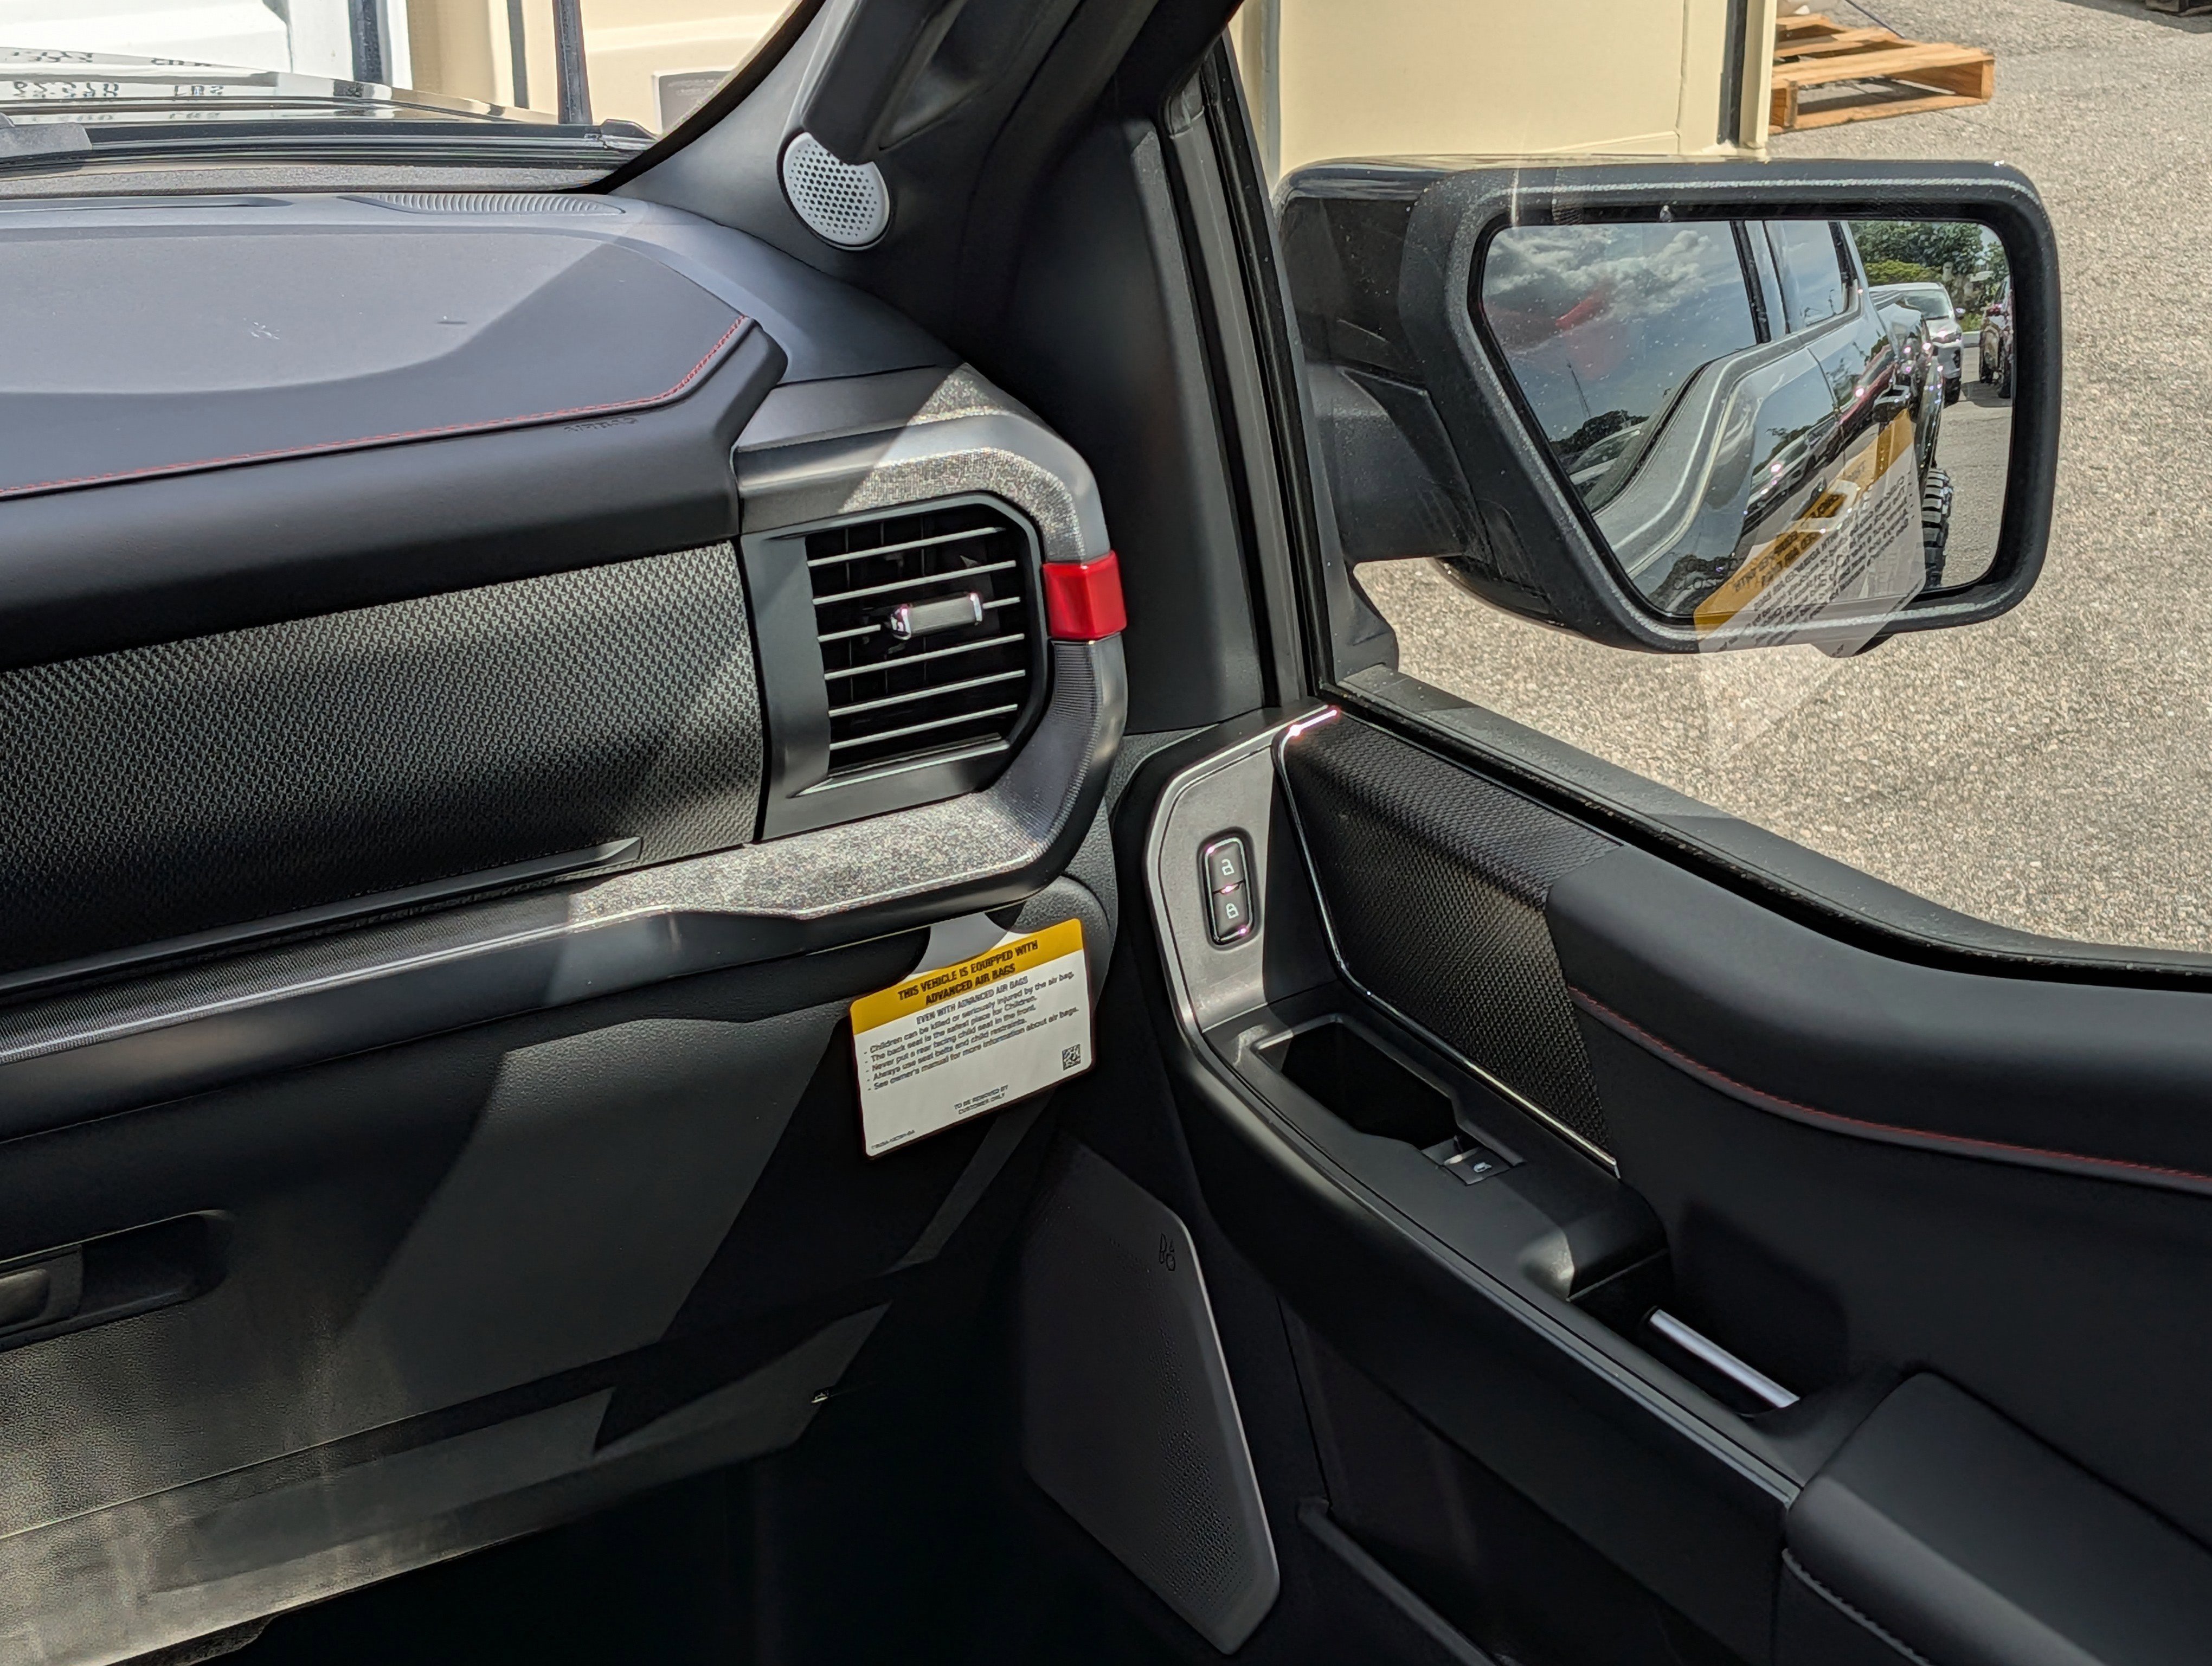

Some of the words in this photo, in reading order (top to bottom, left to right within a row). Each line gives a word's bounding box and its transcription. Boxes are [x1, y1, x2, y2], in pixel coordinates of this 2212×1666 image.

[898, 985, 919, 1000] THIS
[921, 971, 957, 992] VEHICLE
[959, 966, 968, 977] IS
[970, 950, 1013, 973] EQUIPPED
[1014, 939, 1038, 956] WITH
[925, 979, 973, 1005] ADVANCED
[975, 973, 990, 987] AIR
[992, 963, 1015, 980] BAGS
[870, 1036, 902, 1053] Children
[904, 1031, 917, 1040] can
[919, 1027, 929, 1035] be
[930, 1017, 950, 1030] killed
[962, 1002, 995, 1018] seriously
[997, 989, 1023, 1005] injured
[1024, 986, 1033, 995] by
[1034, 982, 1046, 991] the
[1048, 977, 1058, 986] air
[916, 1011, 935, 1024] EVEN
[937, 1003, 955, 1016] WITH
[958, 989, 994, 1009] ADVANCED
[996, 984, 1008, 994] AIR
[1009, 976, 1028, 989] BAGS
[871, 1053, 885, 1062] The
[887, 1045, 905, 1056] back
[907, 1037, 923, 1049] seat
[933, 1030, 945, 1039] the
[947, 1020, 969, 1034] safest
[971, 1013, 991, 1026] place
[992, 1008, 1002, 1016] for
[872, 1059, 894, 1072] Never
[896, 1053, 909, 1065] put
[917, 1045, 931, 1055] rear
[933, 1035, 956, 1048] facing
[958, 1026, 976, 1039] child
[978, 1020, 993, 1031] seat
[1004, 1013, 1015, 1021] the
